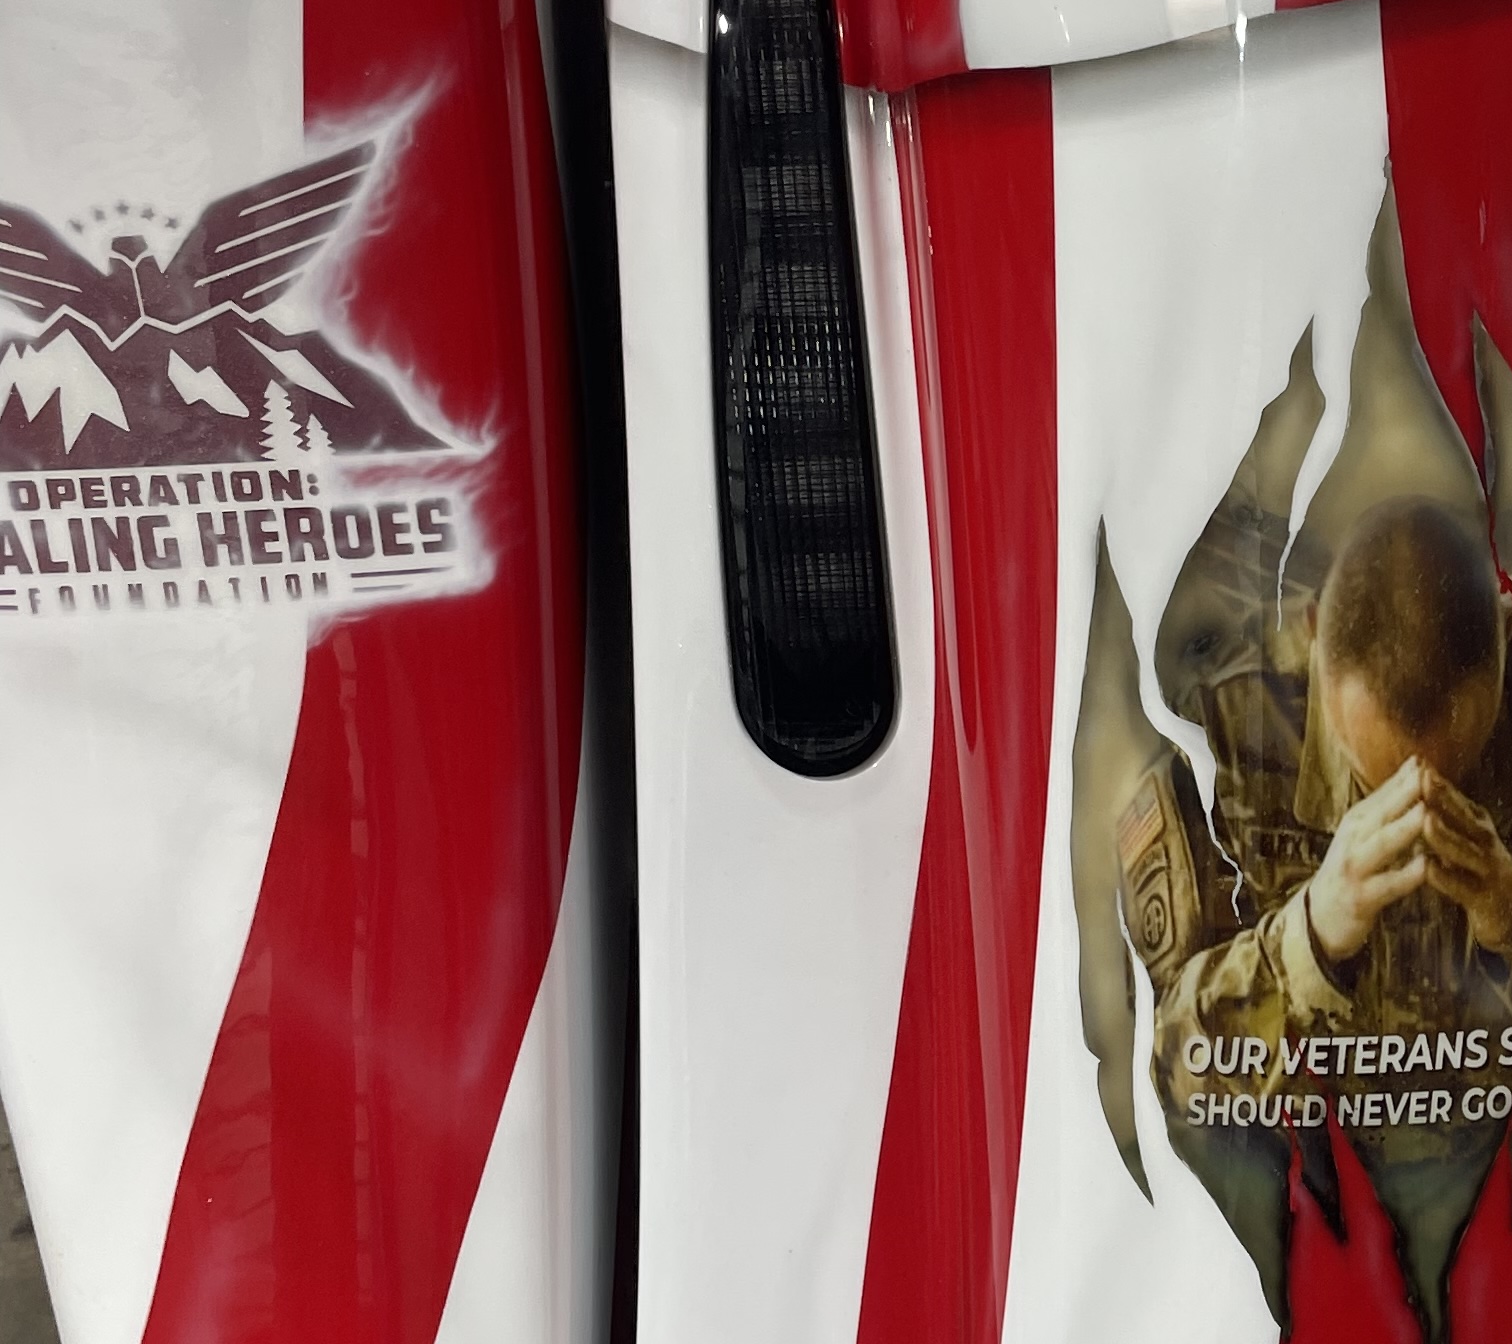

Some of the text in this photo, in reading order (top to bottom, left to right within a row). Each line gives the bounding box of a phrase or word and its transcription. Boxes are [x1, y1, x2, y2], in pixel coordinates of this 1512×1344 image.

[8, 469, 321, 512] OPERATION:
[198, 500, 453, 566] HEROES
[28, 572, 330, 614] FOUNDATION
[1182, 1035, 1268, 1077] OUR
[1280, 1030, 1488, 1076] VETERANS
[1187, 1092, 1326, 1127] SHOULD
[1337, 1091, 1450, 1127] NEVER
[1461, 1084, 1512, 1116] GO
